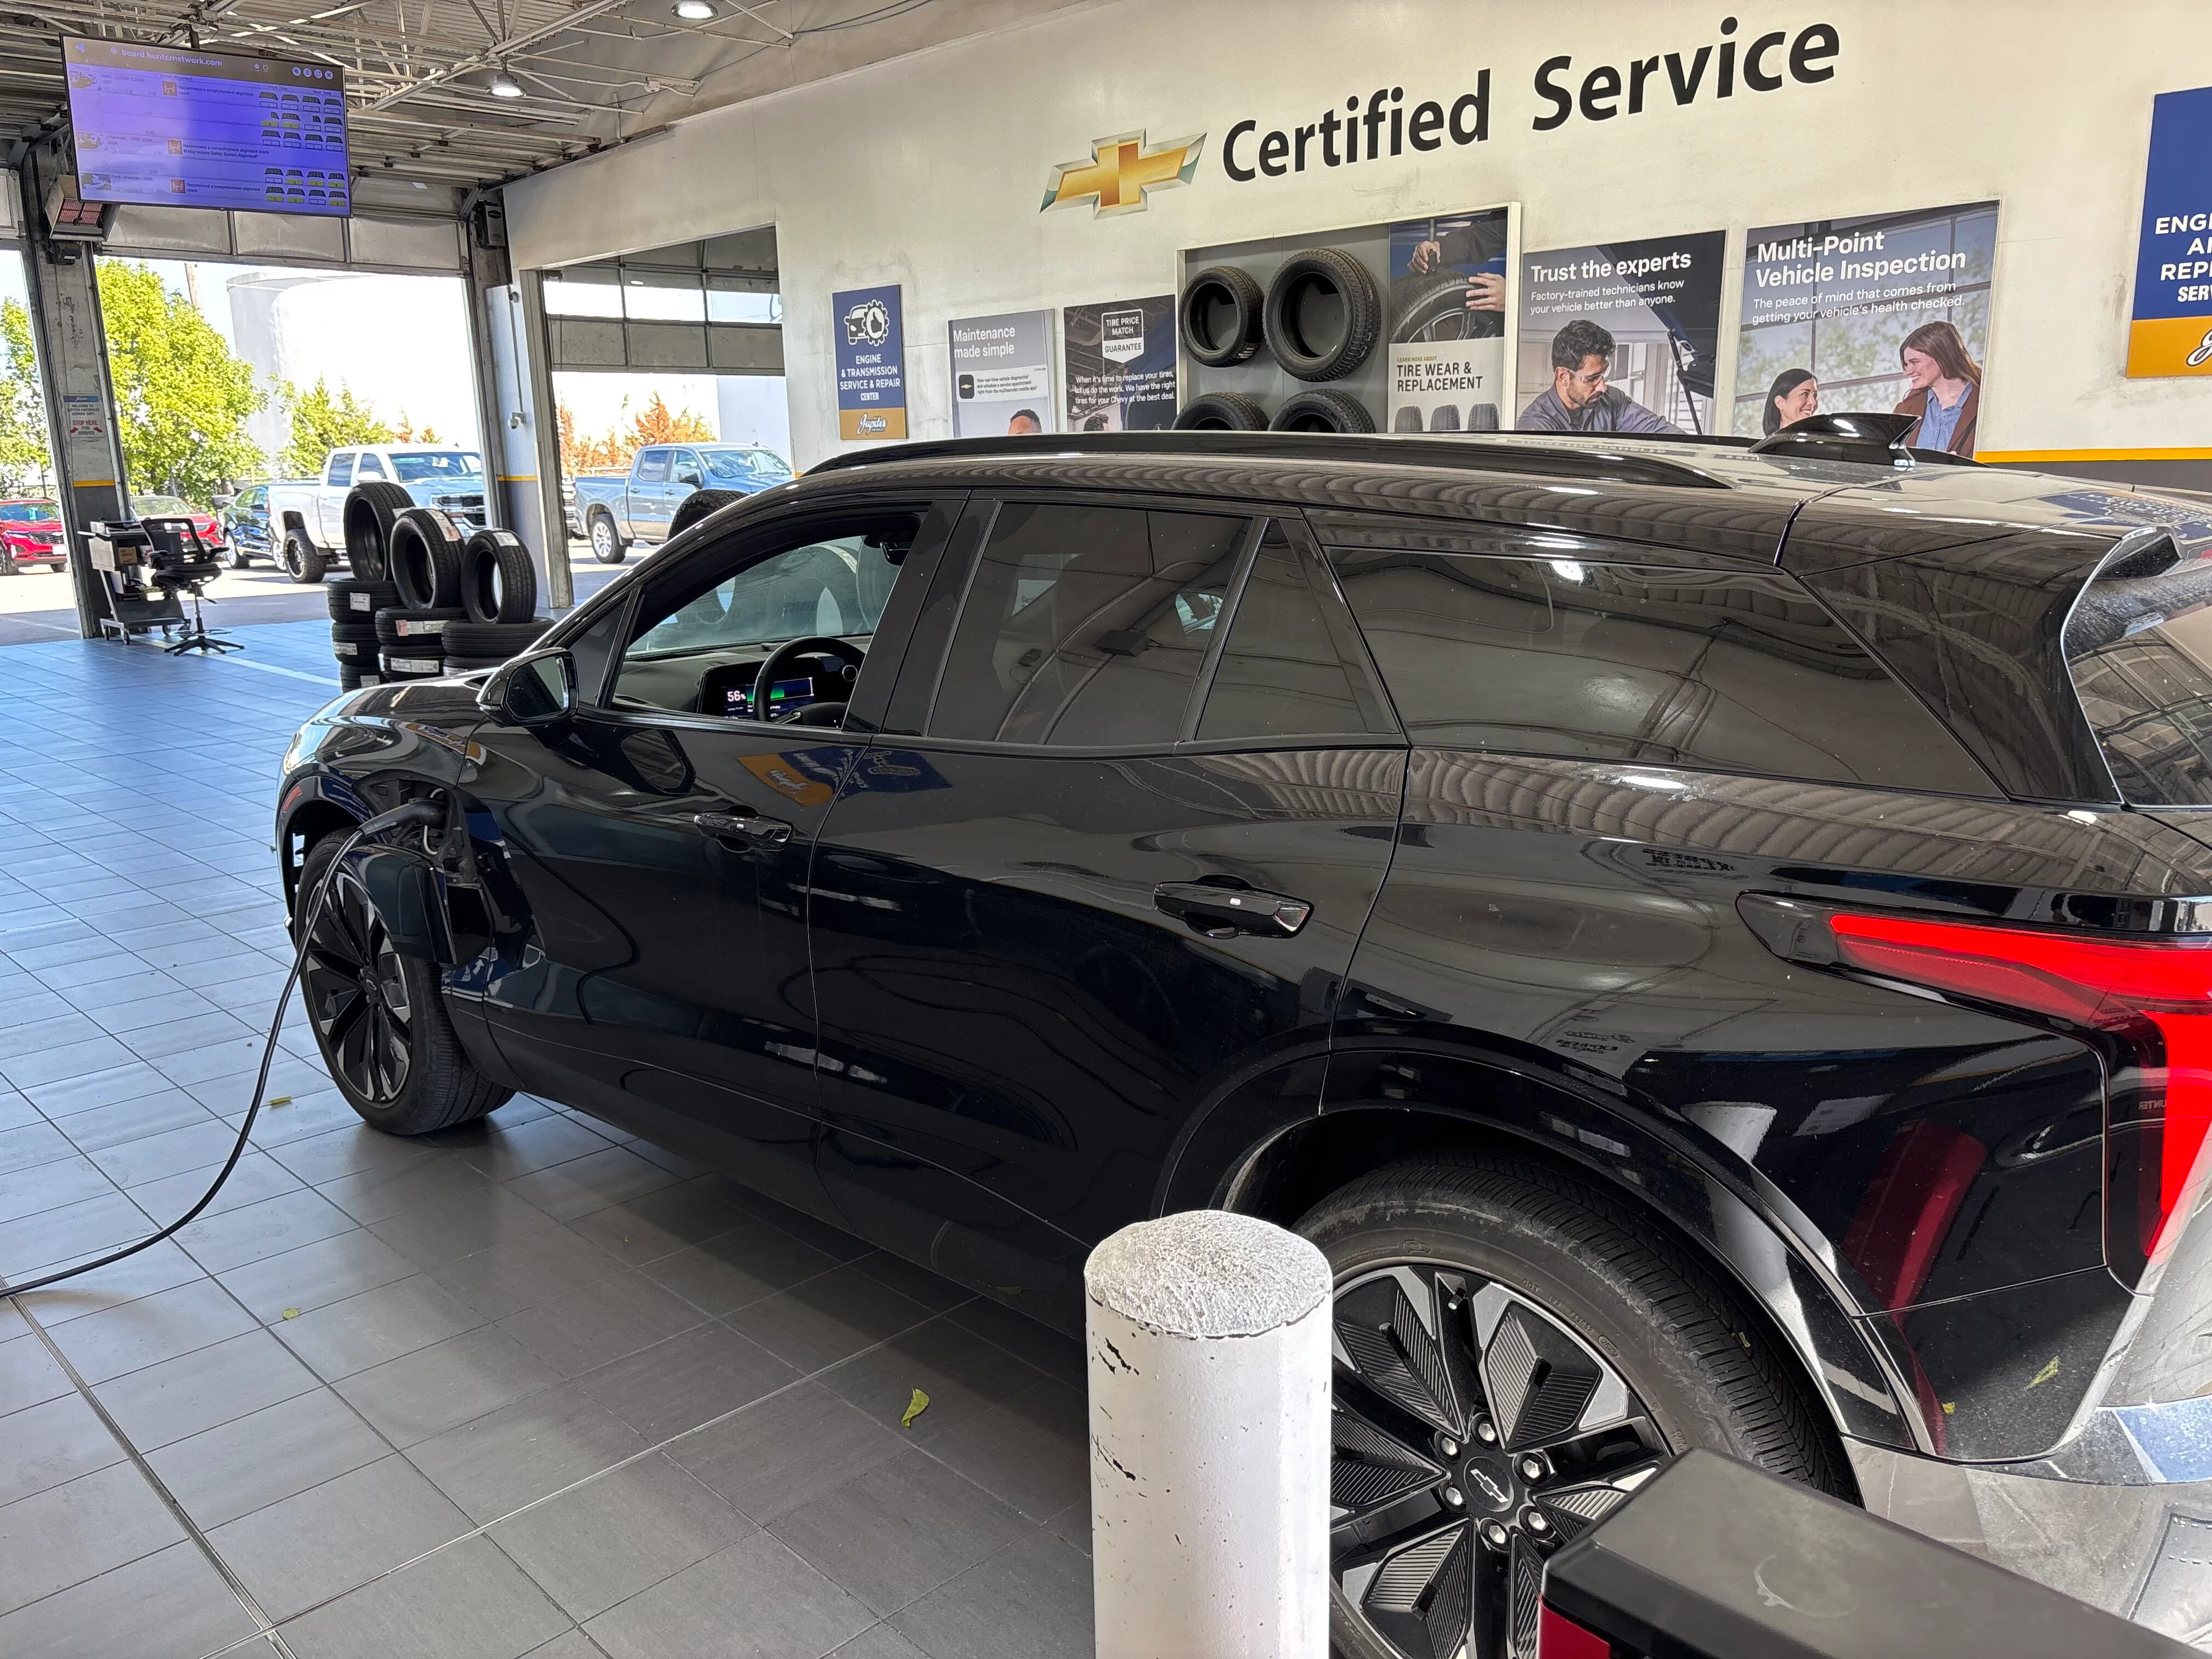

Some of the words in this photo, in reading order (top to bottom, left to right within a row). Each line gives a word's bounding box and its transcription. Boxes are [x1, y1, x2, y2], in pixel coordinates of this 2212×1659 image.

[121, 48, 222, 66] board.hunternetwork.com
[1223, 69, 1491, 182] Certified
[1532, 16, 1839, 131] Service
[1757, 230, 1885, 263] Multi-Point
[1531, 263, 1577, 283] Trust
[1581, 259, 1612, 279] the
[1616, 251, 1691, 277] experts
[1756, 261, 1834, 288] Vehicle
[1840, 250, 1966, 281] Inspection
[1531, 286, 1600, 302] Factory-trained
[1601, 282, 1656, 296] technicians
[1657, 279, 1685, 291] know
[1753, 298, 1773, 309] The
[1775, 296, 1808, 310] peace
[1811, 292, 1824, 304] of
[1825, 289, 1854, 303] mind
[1857, 288, 1881, 300] that
[1883, 286, 1923, 298] comes
[1926, 281, 1956, 294] from
[1530, 306, 1550, 317] your
[1551, 301, 1582, 313] vehicle
[1584, 300, 1613, 312] better
[1615, 297, 1637, 308] than
[1638, 295, 1676, 307] anyone.
[1752, 310, 1791, 326] getting
[1793, 311, 1819, 322] your
[1820, 303, 1868, 319] vehicle's
[1870, 300, 1908, 314] health
[1910, 294, 1966, 311] checked.
[1105, 318, 1120, 328] TIRE
[1120, 316, 1140, 326] PRICE
[953, 327, 1015, 342] Maintenance
[1111, 326, 1134, 336] MATCH
[954, 344, 981, 358] made
[982, 341, 1015, 358] simple
[1104, 342, 1142, 354] GUARANTEE
[855, 353, 882, 365] ENGINE
[841, 369, 847, 378] &
[847, 365, 898, 378] TRANSMISSION
[1075, 375, 1092, 384] When
[1092, 375, 1102, 383] it's
[1102, 375, 1115, 383] time
[1115, 374, 1122, 382] to
[1122, 371, 1144, 383] replace
[1144, 371, 1158, 381] your
[1159, 370, 1174, 379] tires,
[1397, 364, 1421, 377] TIRE
[1425, 362, 1460, 376] WEAR
[1463, 361, 1472, 375] &
[839, 380, 868, 391] SERVICE
[869, 379, 874, 389] &
[876, 378, 901, 388] REPAIR
[1074, 385, 1083, 394] let
[1090, 385, 1098, 393] do
[1098, 385, 1108, 393] the
[1108, 383, 1125, 393] work.
[1125, 383, 1135, 392] We
[1136, 383, 1150, 391] have
[1161, 380, 1176, 391] right
[1397, 376, 1483, 392] REPLACEMENT
[860, 392, 879, 401] CENTER
[1075, 396, 1088, 405] tires
[1088, 396, 1097, 404] for
[1097, 397, 1110, 405] your
[1110, 394, 1128, 404] Chevy
[1129, 394, 1135, 403] at
[1136, 393, 1146, 402] the
[1147, 392, 1160, 401] best
[1161, 391, 1175, 400] deal.
[856, 413, 887, 435] Jupiter
[727, 691, 746, 702] 56%
